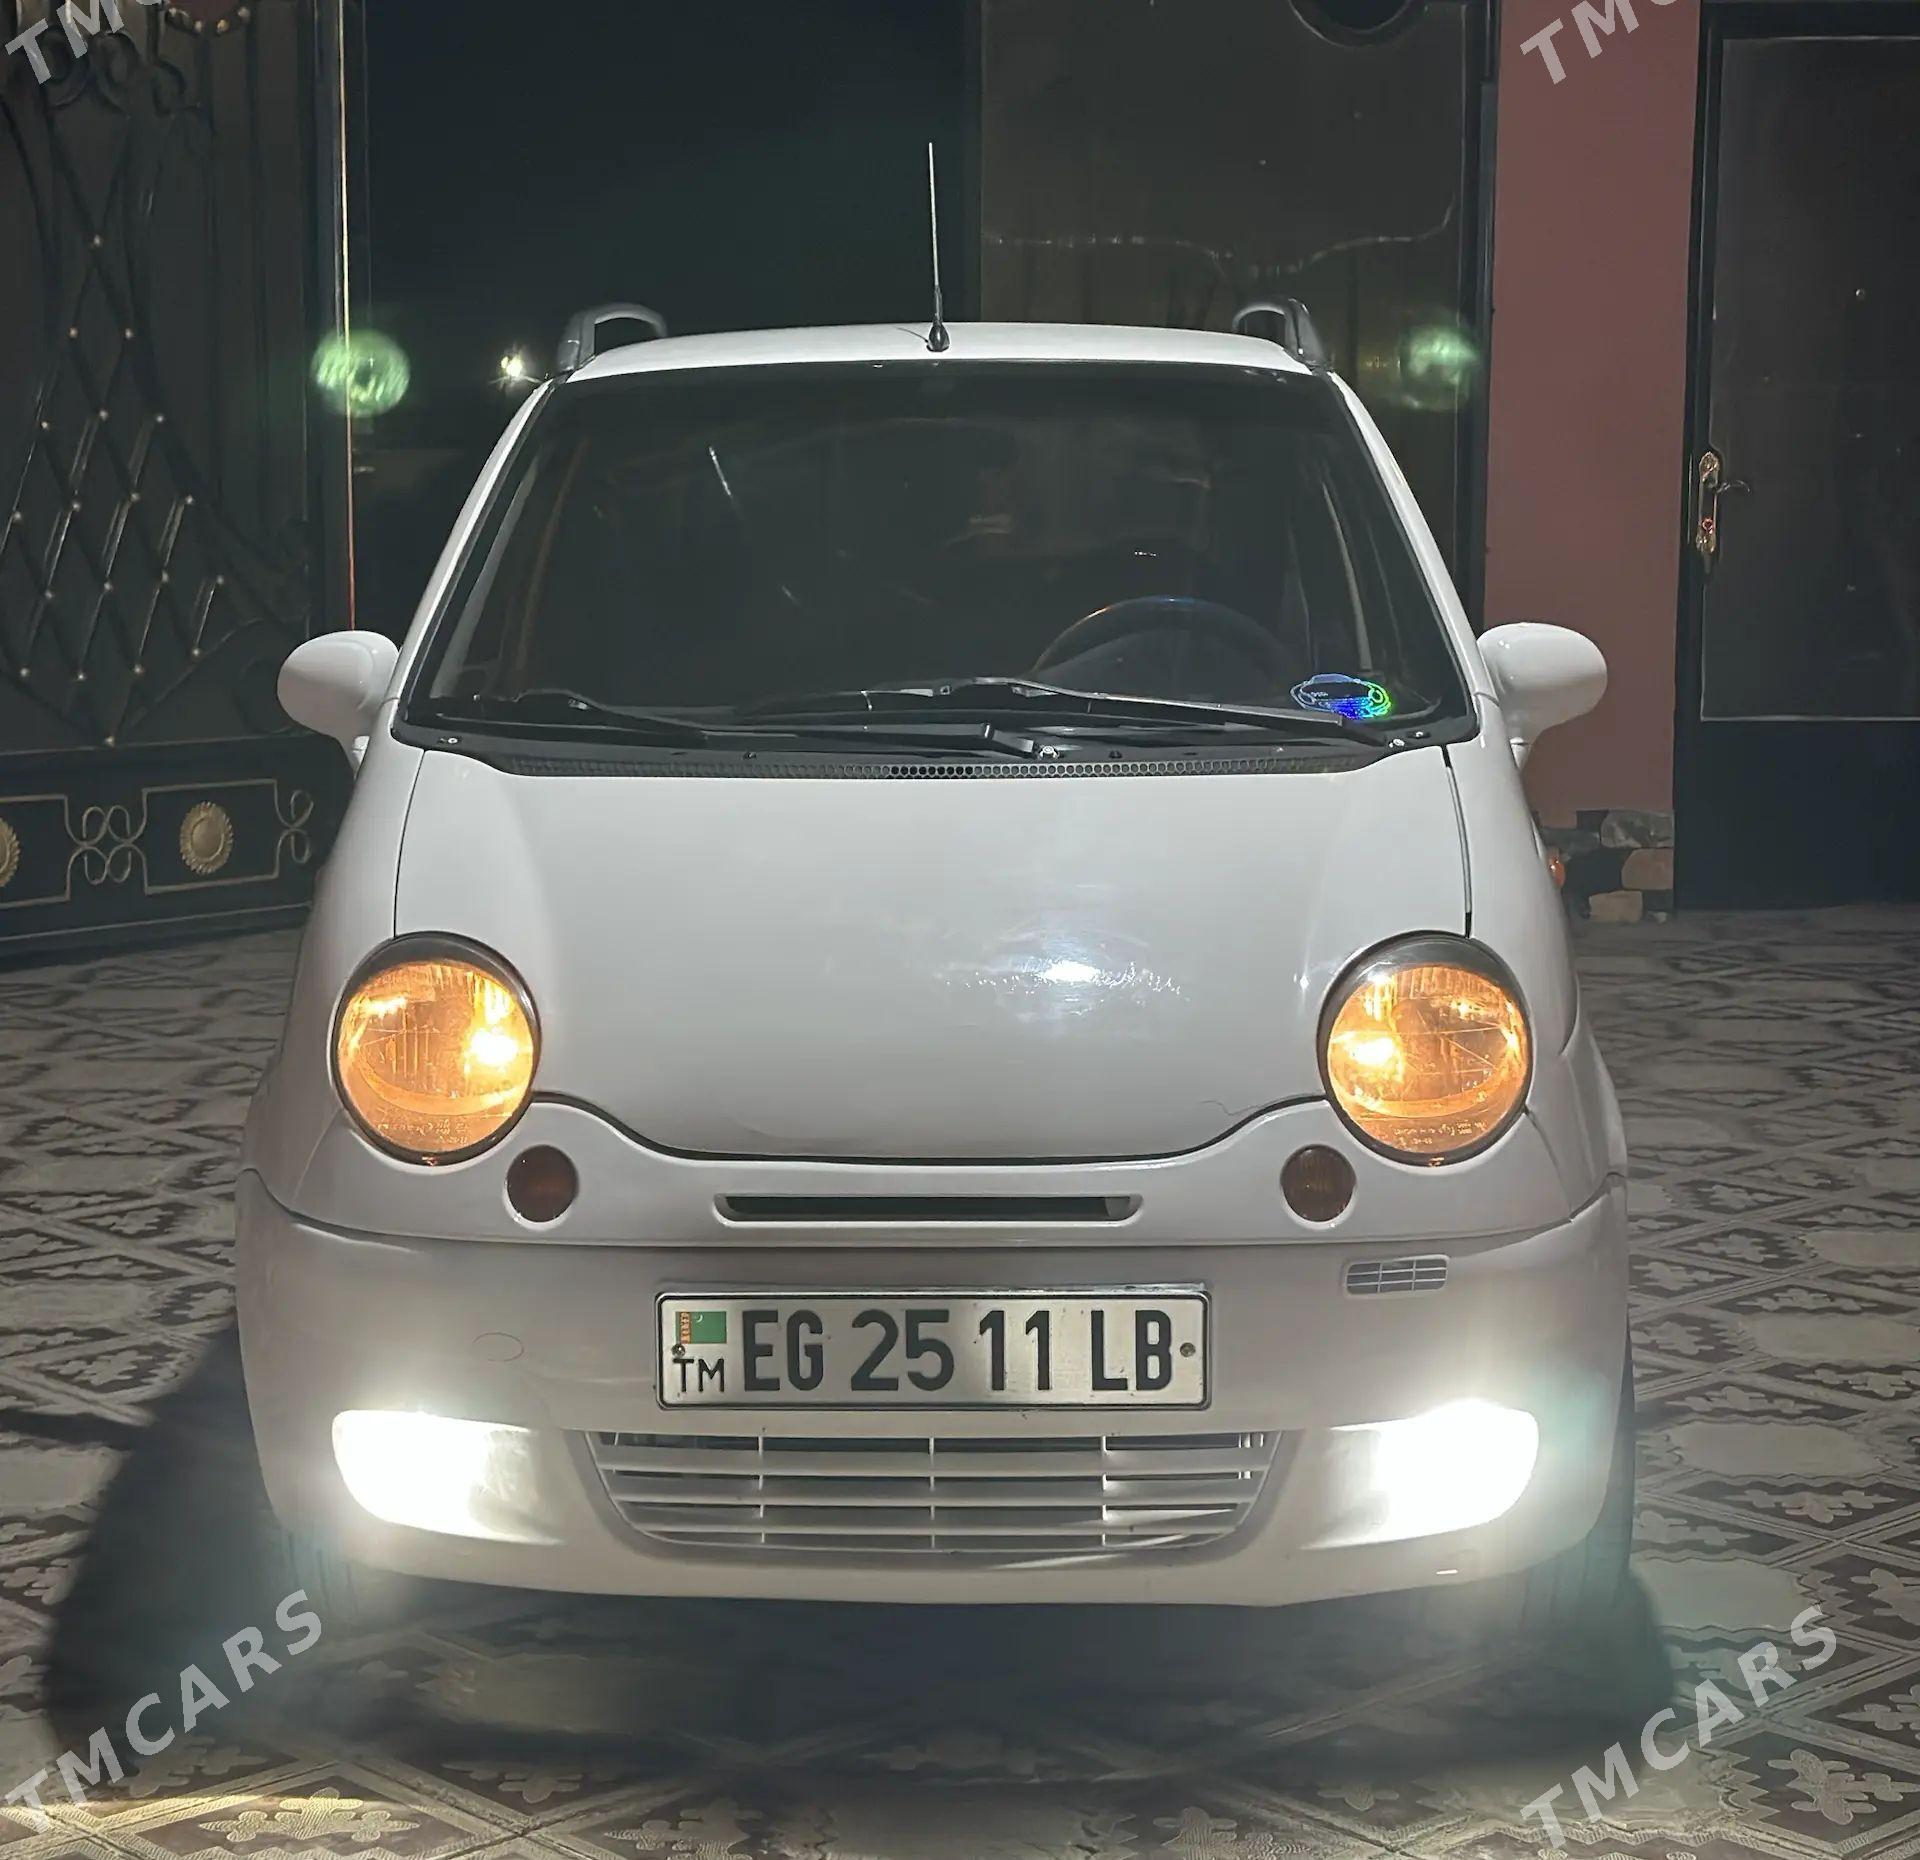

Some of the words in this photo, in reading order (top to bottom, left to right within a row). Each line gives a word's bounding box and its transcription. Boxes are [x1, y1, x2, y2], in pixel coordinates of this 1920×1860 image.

[673, 1357, 726, 1393] TM
[742, 1309, 824, 1392] EG
[851, 1309, 954, 1392] 25
[979, 1309, 1051, 1391] 11
[1091, 1309, 1173, 1392] LB
